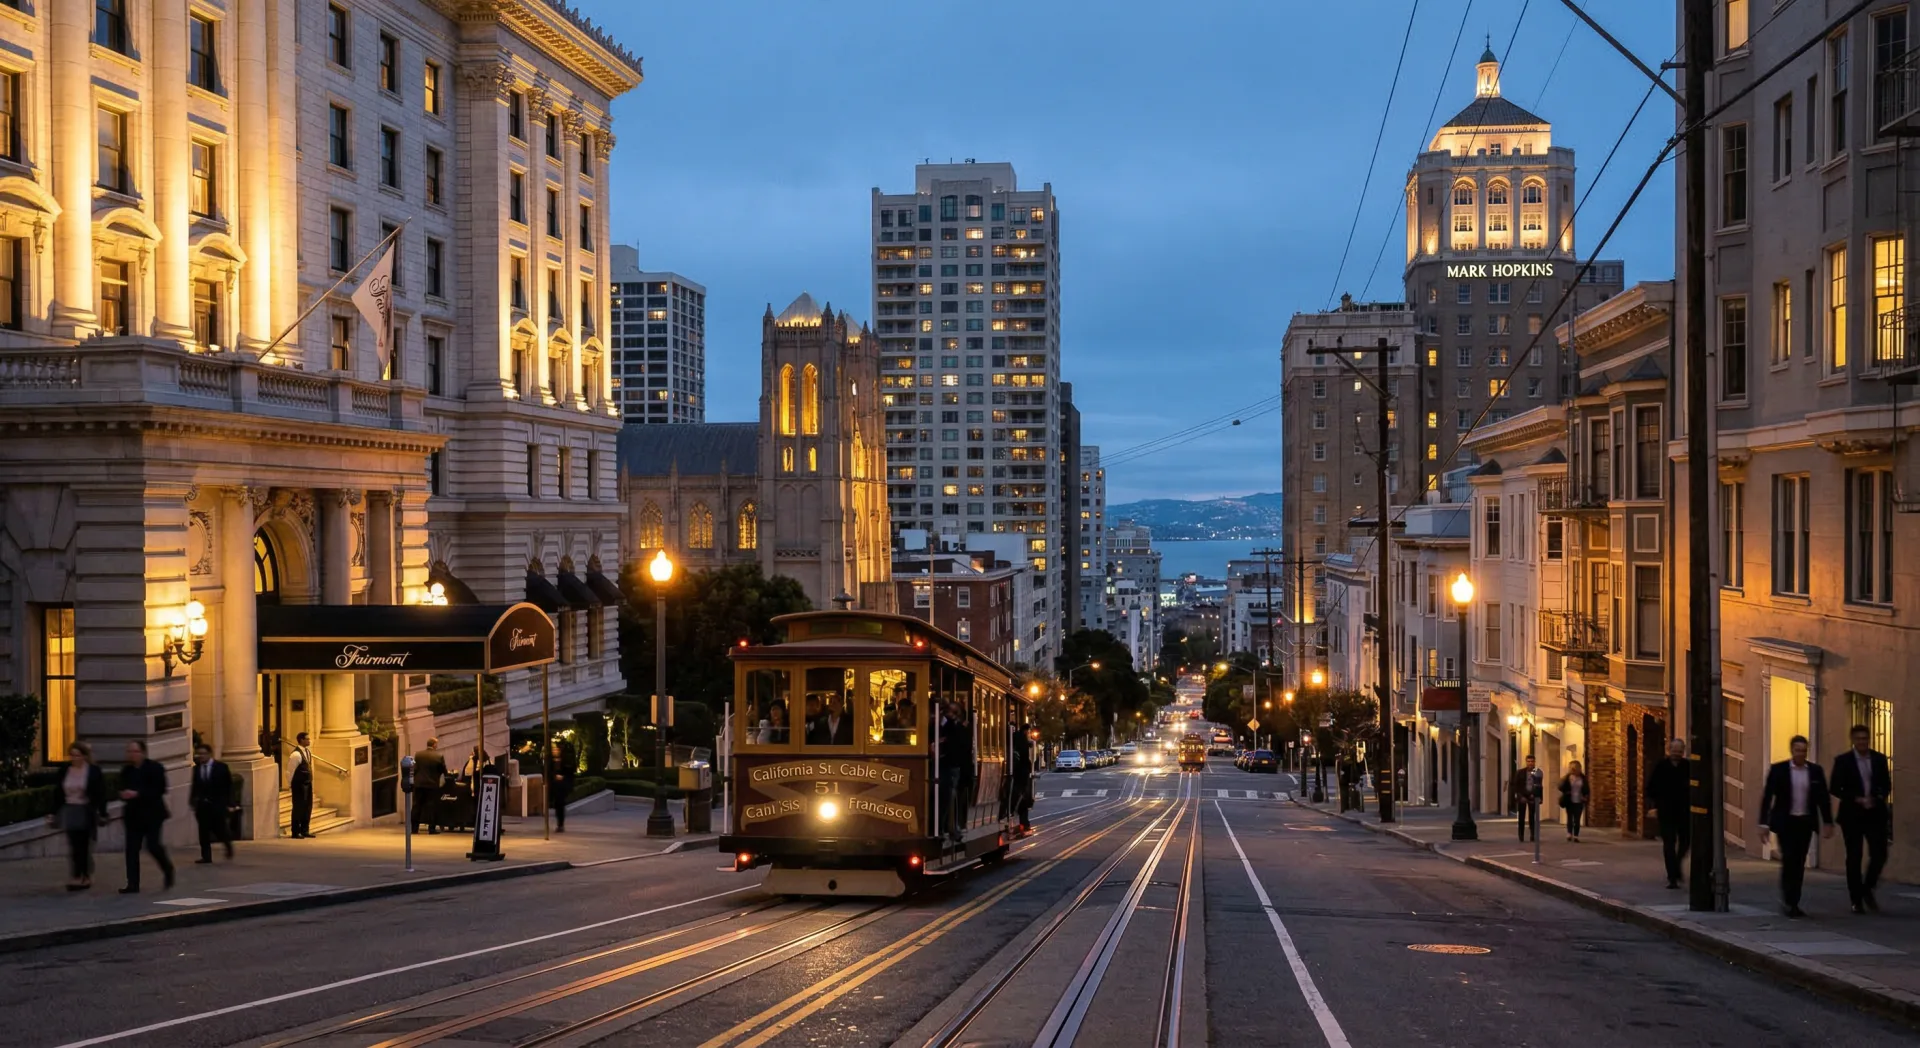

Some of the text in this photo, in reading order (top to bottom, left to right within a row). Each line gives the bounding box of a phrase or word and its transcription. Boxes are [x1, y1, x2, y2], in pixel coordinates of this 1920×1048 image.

[1447, 263, 1554, 278] MARK HOPKINS
[335, 644, 412, 668] Fairmont
[753, 763, 813, 781] California
[819, 762, 836, 775] St.
[840, 763, 877, 779] Cable
[815, 781, 841, 795] 51
[848, 797, 912, 820] Francisco
